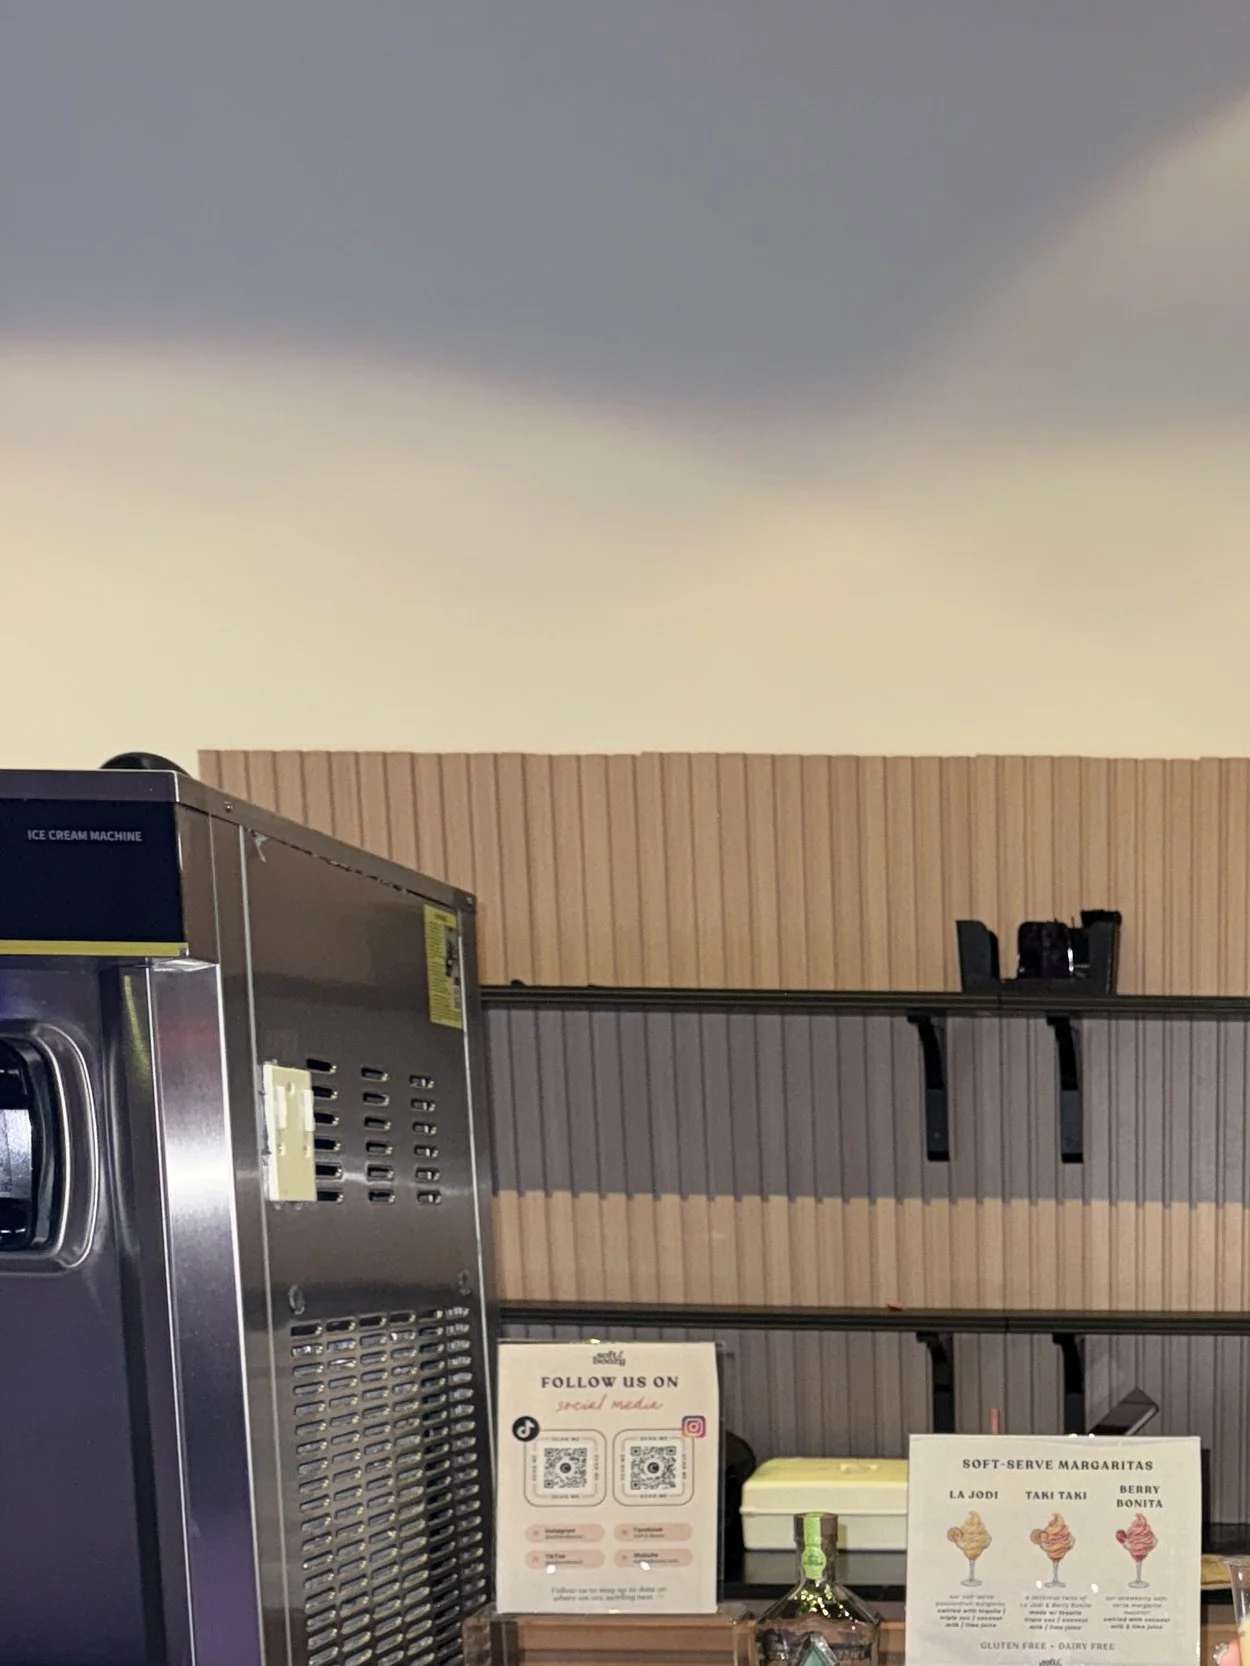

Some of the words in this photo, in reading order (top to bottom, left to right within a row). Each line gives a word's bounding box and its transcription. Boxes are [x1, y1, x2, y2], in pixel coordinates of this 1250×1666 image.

[28, 830, 45, 840] ICE
[48, 830, 87, 840] CREAM
[90, 830, 142, 842] MACHINE
[541, 1376, 616, 1388] FOLLOW
[623, 1377, 647, 1388] US
[653, 1377, 678, 1388] ON
[556, 1394, 607, 1412] social
[611, 1397, 663, 1410] media
[962, 1459, 1053, 1470] SOFT-SERVE
[1058, 1460, 1153, 1470] MARGARITAS
[1120, 1485, 1161, 1494] BERRY
[949, 1491, 965, 1499] LA
[968, 1491, 999, 1499] JODI
[1025, 1491, 1054, 1500] TAKI
[1059, 1491, 1087, 1500] TAKI
[1116, 1499, 1163, 1508] BONITA
[980, 1641, 1019, 1650] GLUTEN
[1022, 1641, 1046, 1650] FREE
[1058, 1642, 1088, 1651] DAIRY
[1091, 1642, 1115, 1651] FREE
